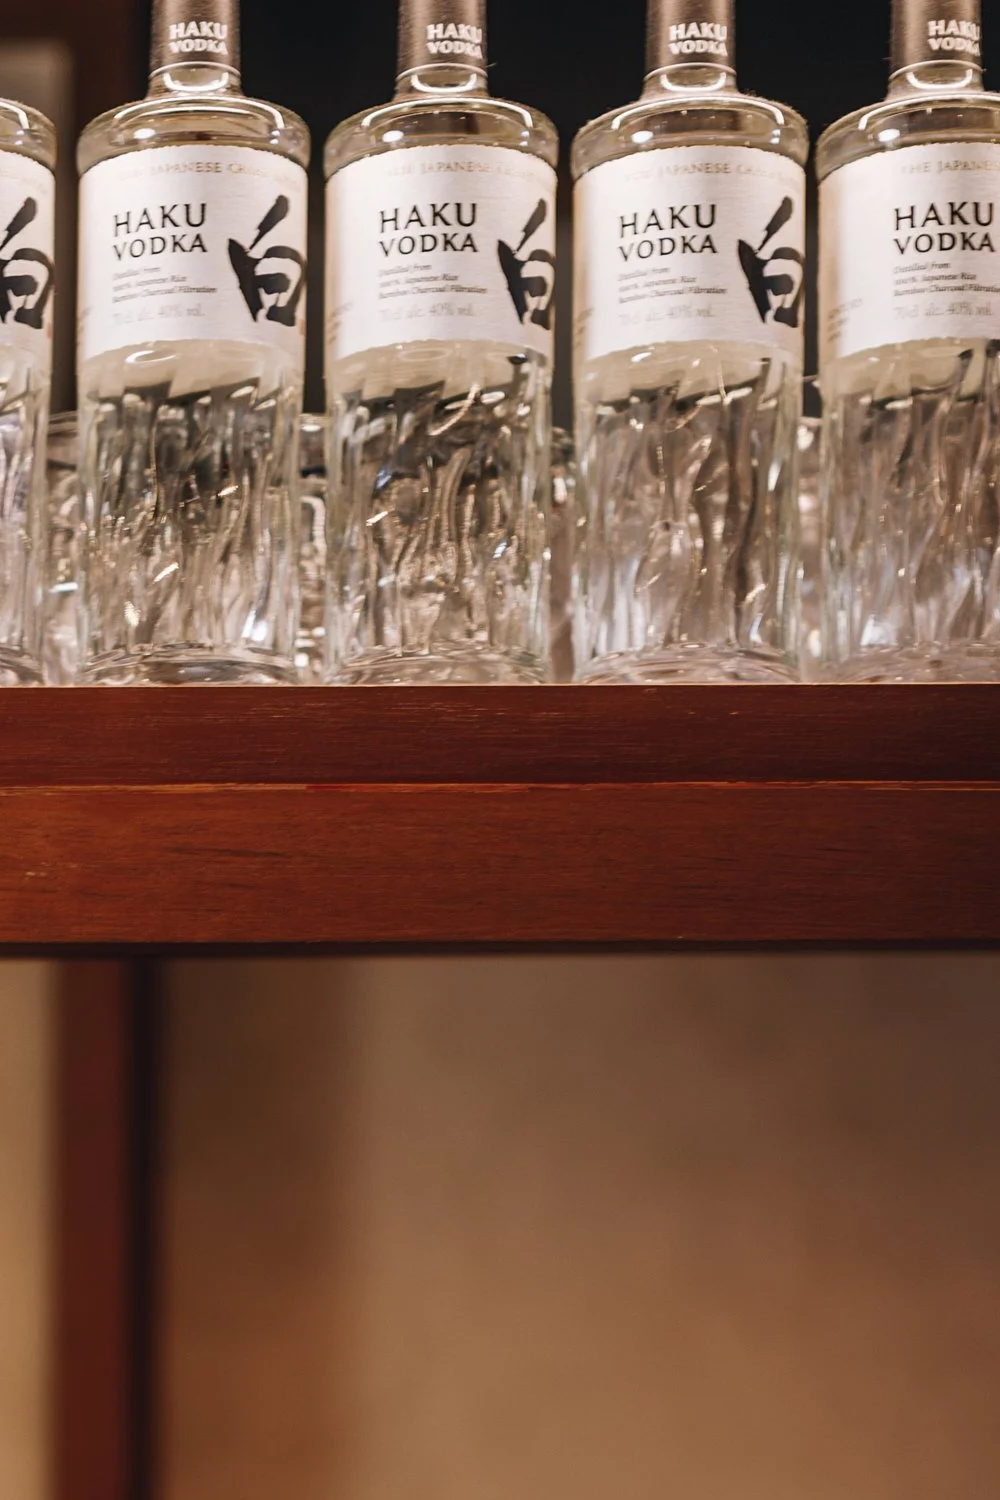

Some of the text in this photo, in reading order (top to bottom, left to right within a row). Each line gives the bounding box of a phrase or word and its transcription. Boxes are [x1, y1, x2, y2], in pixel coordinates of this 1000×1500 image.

[169, 21, 228, 40] HAKU
[426, 23, 482, 43] HAKU
[669, 22, 727, 40] HAKU
[928, 19, 980, 40] HAKU
[168, 39, 228, 55] VODKA
[426, 40, 483, 59] VODKA
[668, 40, 728, 56] VODKA
[927, 37, 980, 56] VODKA
[113, 203, 207, 237] HAKU
[379, 202, 478, 233] HAKU
[620, 204, 716, 238] HAKU
[894, 201, 994, 231] HAKU
[113, 233, 208, 261] VODKA
[379, 233, 479, 257] VODKA
[618, 234, 718, 261] VODKA
[893, 232, 995, 254] VODKA
